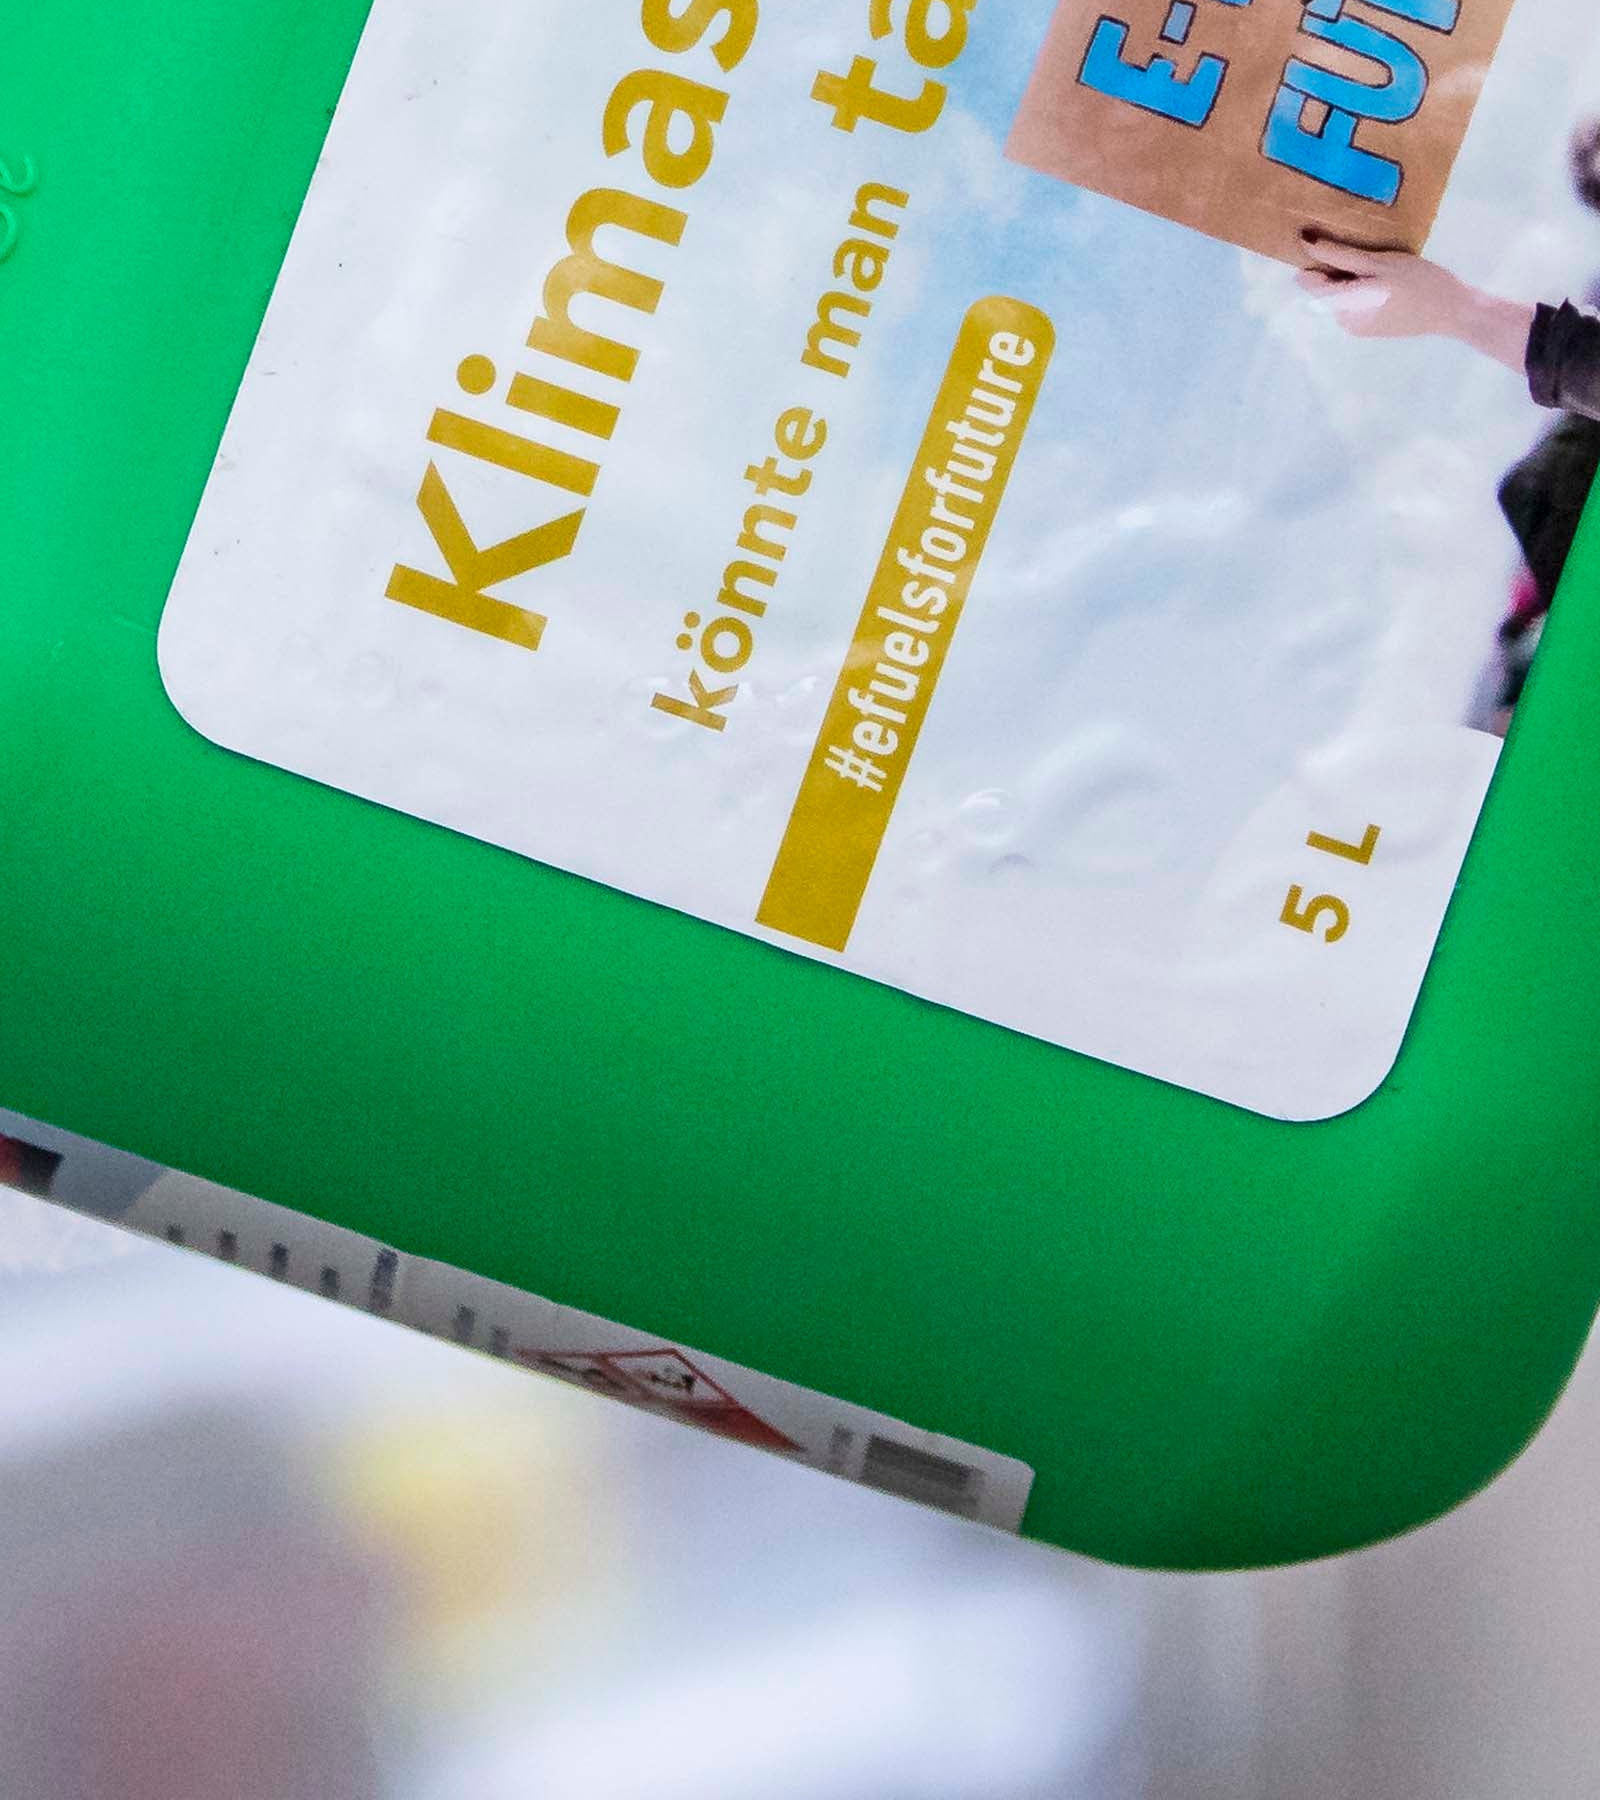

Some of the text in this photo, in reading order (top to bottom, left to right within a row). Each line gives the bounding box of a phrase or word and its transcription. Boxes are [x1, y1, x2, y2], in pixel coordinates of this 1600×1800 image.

[650, 406, 828, 732] könnte
[800, 182, 910, 379] man
[823, 330, 1036, 793] #efuelsforfuture
[1279, 823, 1381, 945] 5 L
